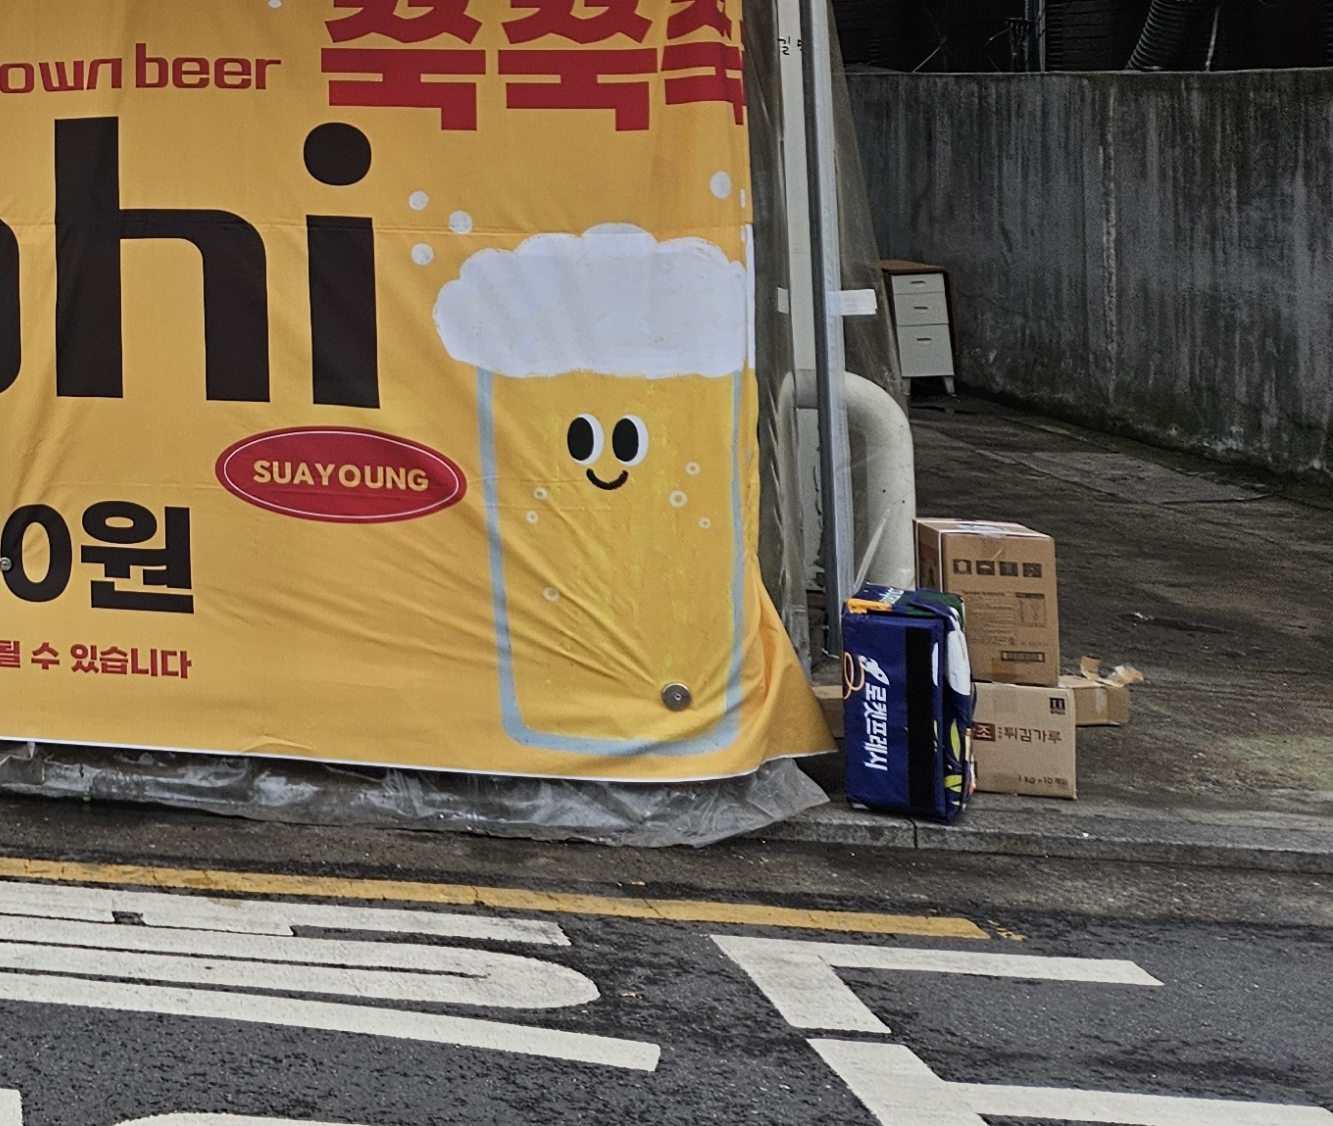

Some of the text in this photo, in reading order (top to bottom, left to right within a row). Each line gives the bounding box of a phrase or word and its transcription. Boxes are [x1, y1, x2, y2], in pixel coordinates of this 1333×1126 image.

[134, 42, 282, 91] beer
[252, 458, 430, 493] SUAYOUNG
[29, 641, 62, 671] 수
[69, 643, 193, 680] 있습니다
[862, 682, 889, 772] 로켓프레시
[1004, 726, 1064, 745] 튀김가루
